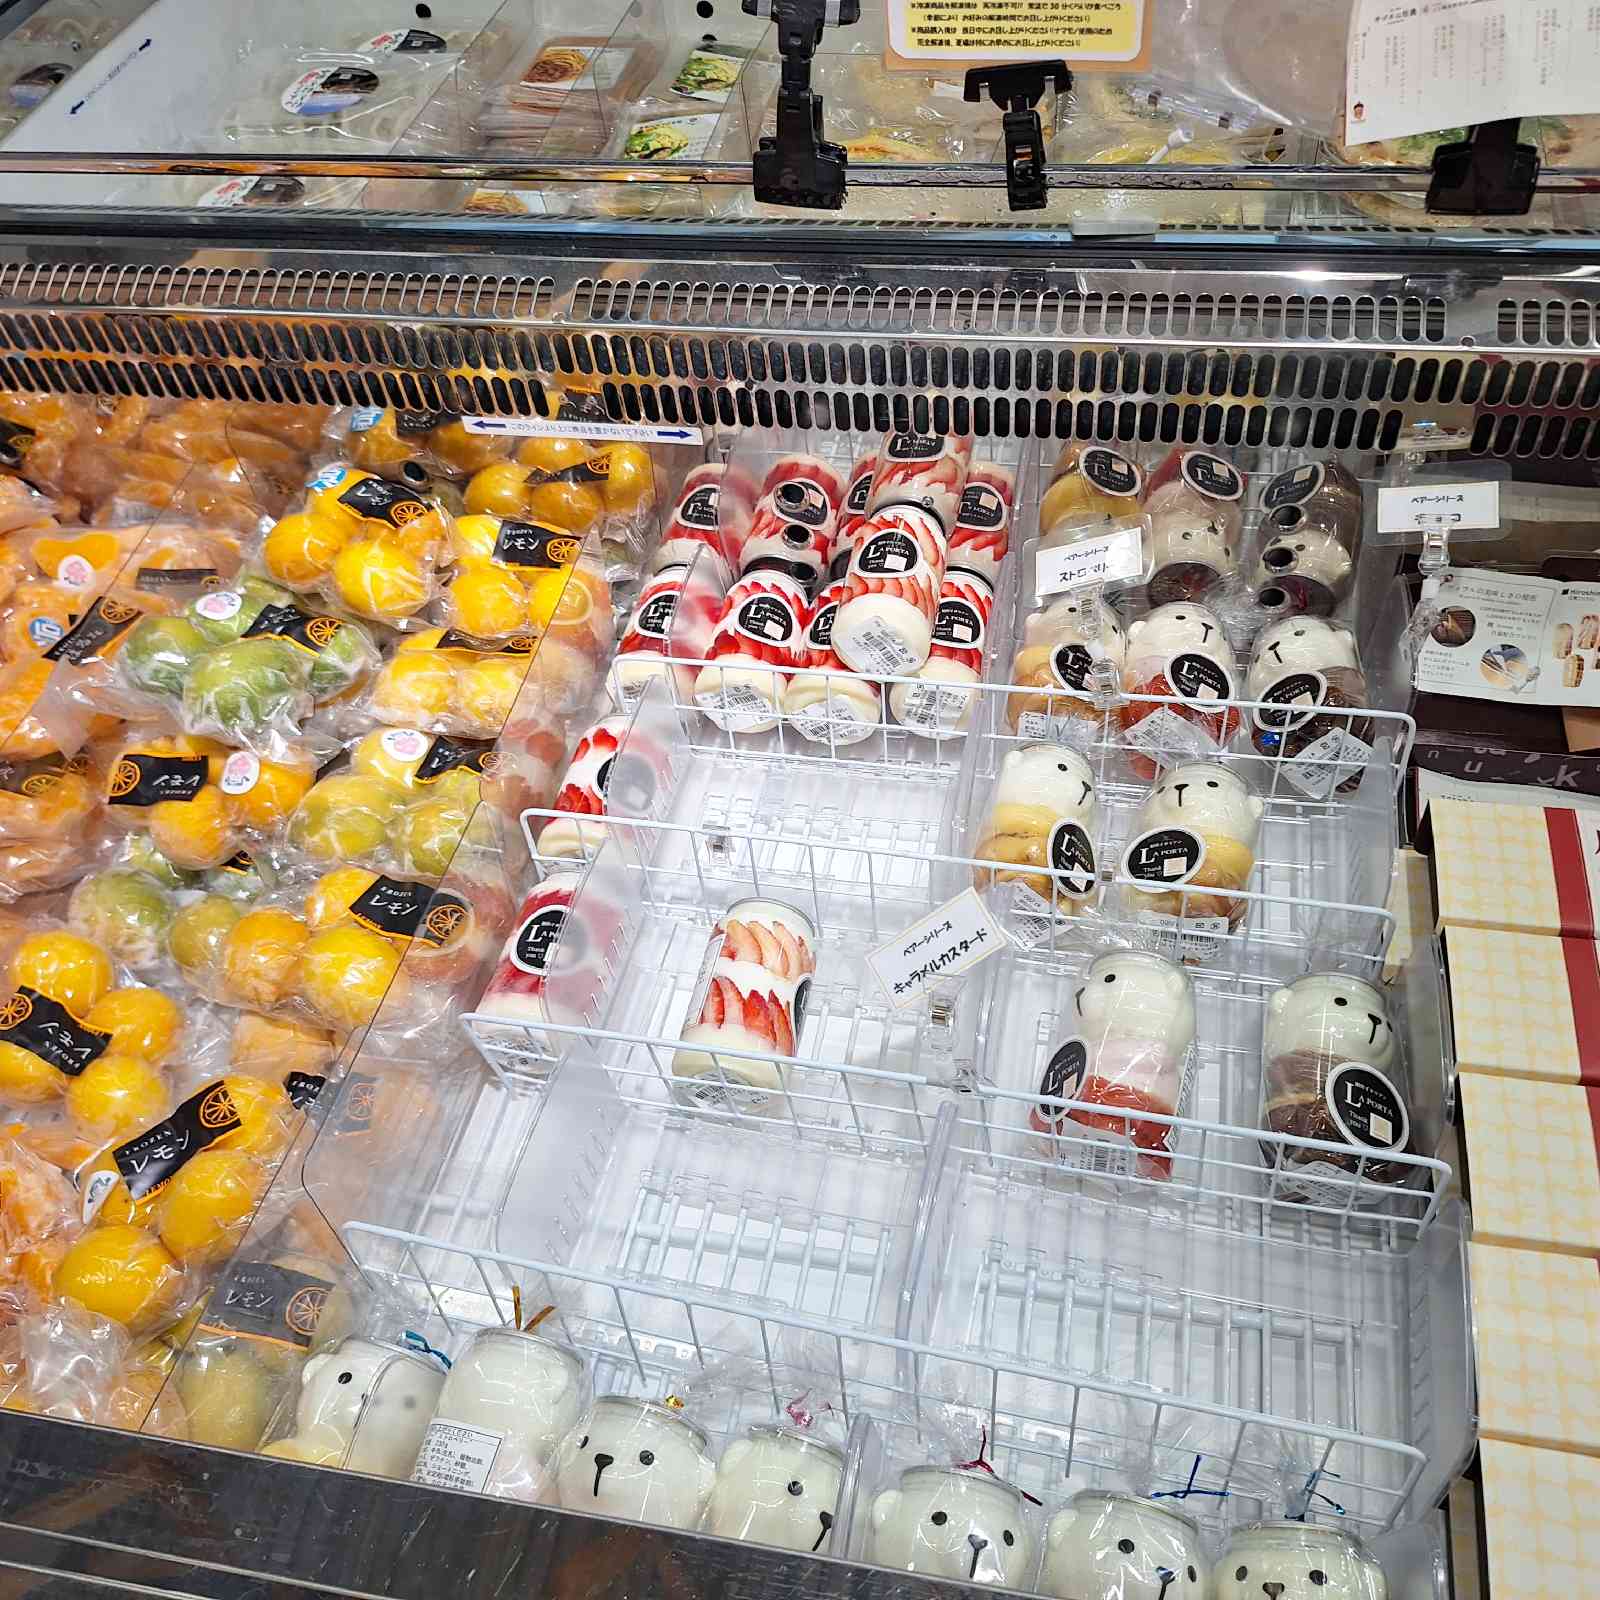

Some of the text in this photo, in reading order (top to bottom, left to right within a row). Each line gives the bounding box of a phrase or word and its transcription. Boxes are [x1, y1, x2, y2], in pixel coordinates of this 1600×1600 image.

[503, 537, 540, 551] レモン
[152, 774, 201, 787] レモン
[369, 895, 418, 915] レモン
[894, 928, 988, 994] キャラメルカスタード
[38, 1022, 92, 1060] レモン
[130, 1129, 190, 1173] レモン
[225, 1288, 274, 1308] レモン
